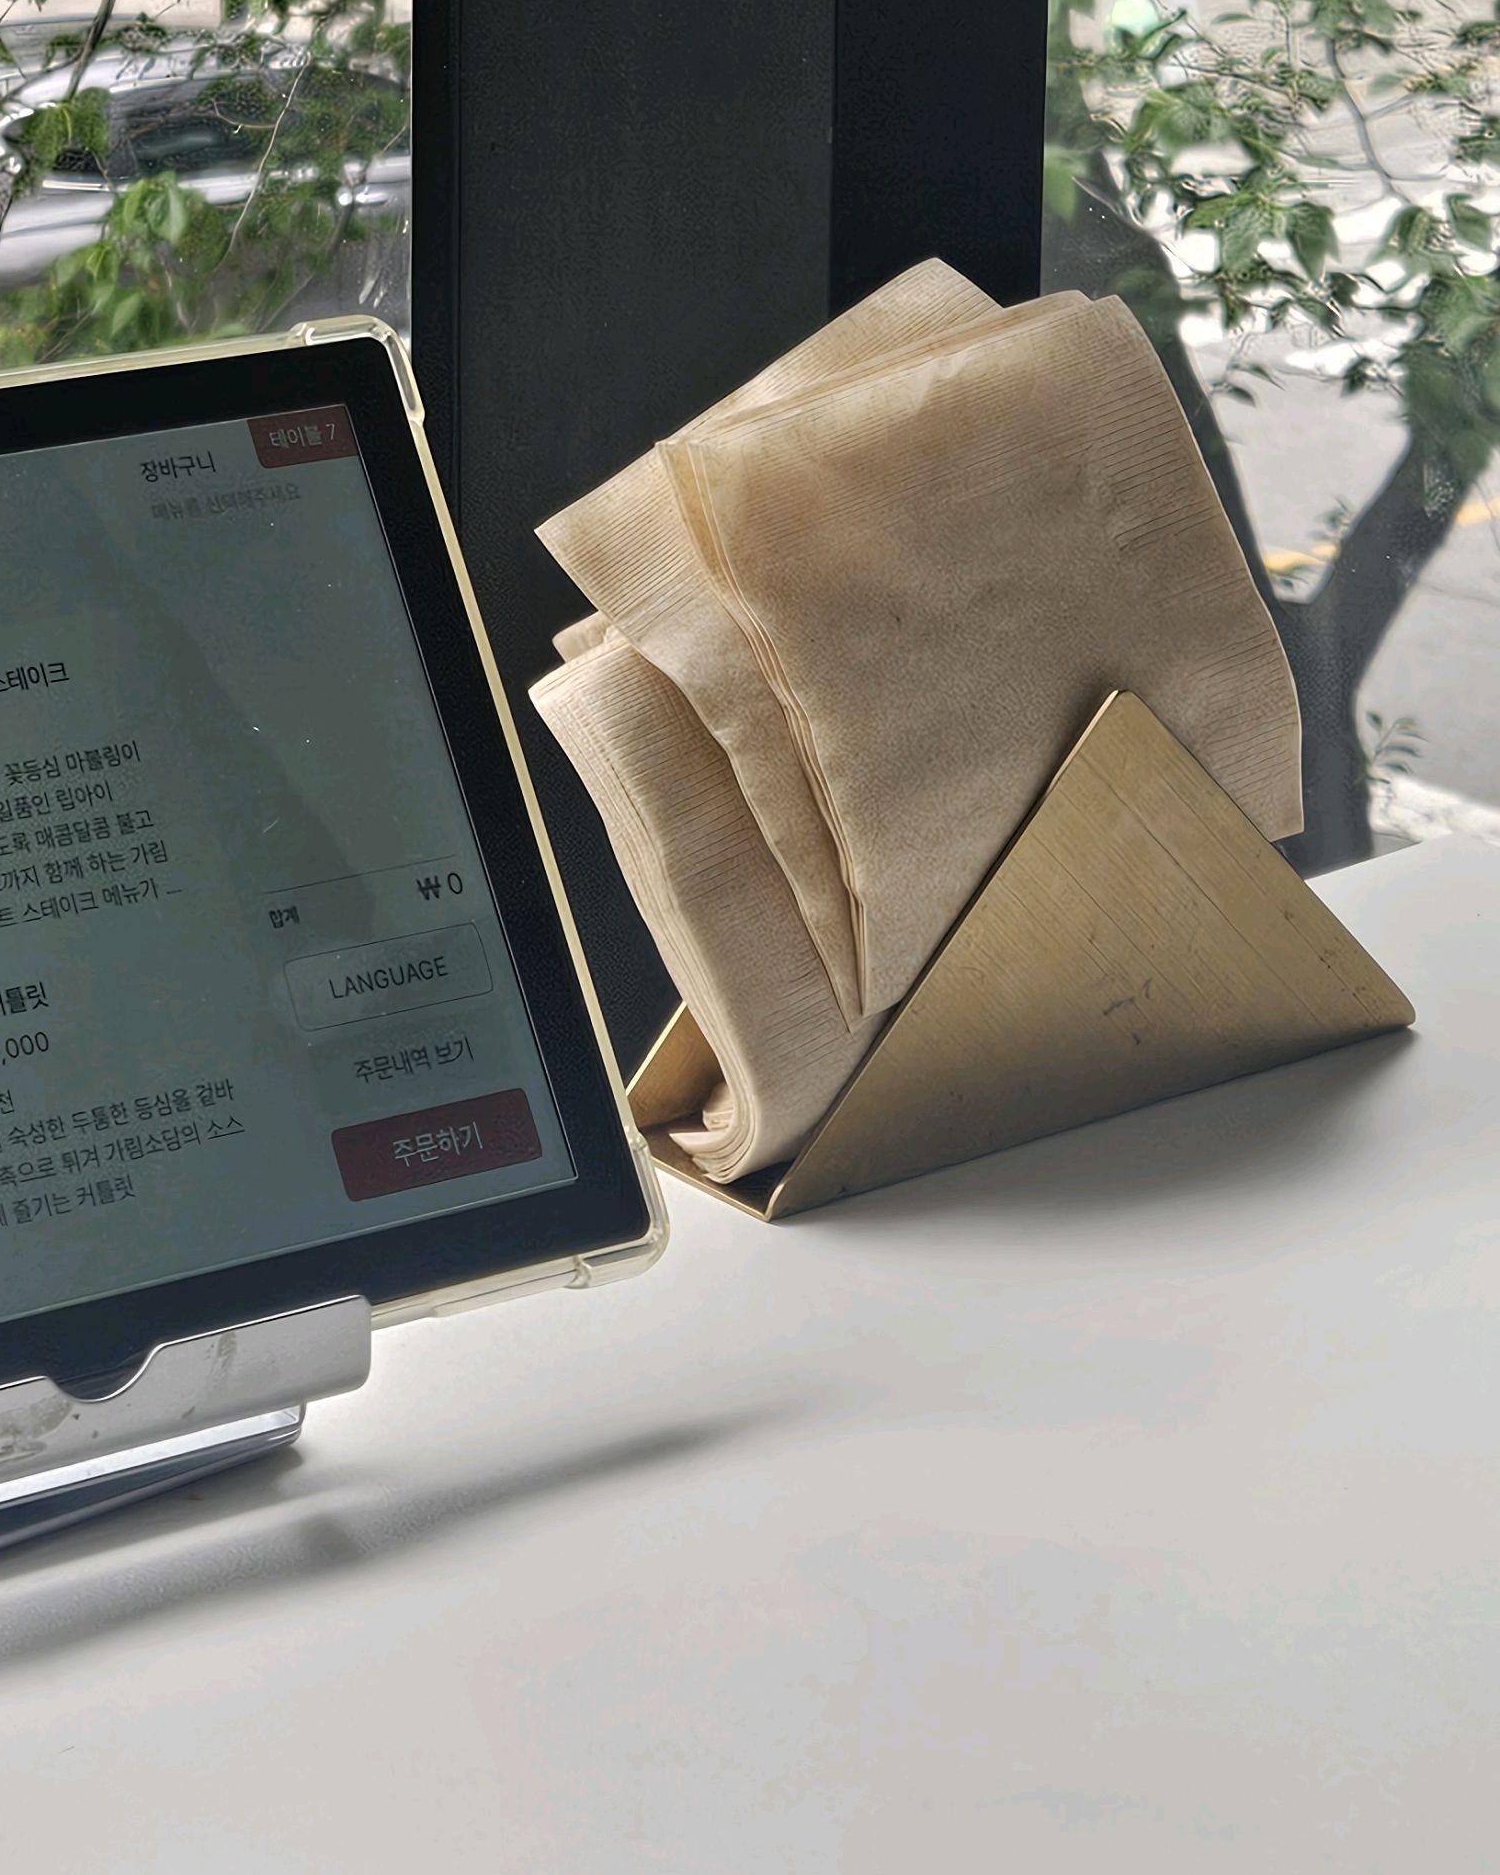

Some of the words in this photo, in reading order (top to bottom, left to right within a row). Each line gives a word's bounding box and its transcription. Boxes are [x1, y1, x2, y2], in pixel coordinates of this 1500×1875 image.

[268, 425, 323, 449] 테이블
[325, 423, 336, 441] 7
[140, 451, 217, 483] 장바구니
[55, 780, 114, 813] 립아이
[129, 839, 169, 866] 가림
[22, 891, 99, 924] 스테이크
[102, 877, 161, 907] 메뉴가
[328, 956, 449, 999] LANGUAGE
[354, 1046, 431, 1084] 주문내역
[435, 1036, 475, 1066] 보기
[7, 1118, 66, 1147] 숙성한
[134, 1087, 191, 1121] 등심을
[207, 1115, 245, 1140] 소스
[392, 1121, 484, 1167] 주문하기
[76, 1174, 137, 1208] 커틀릿
